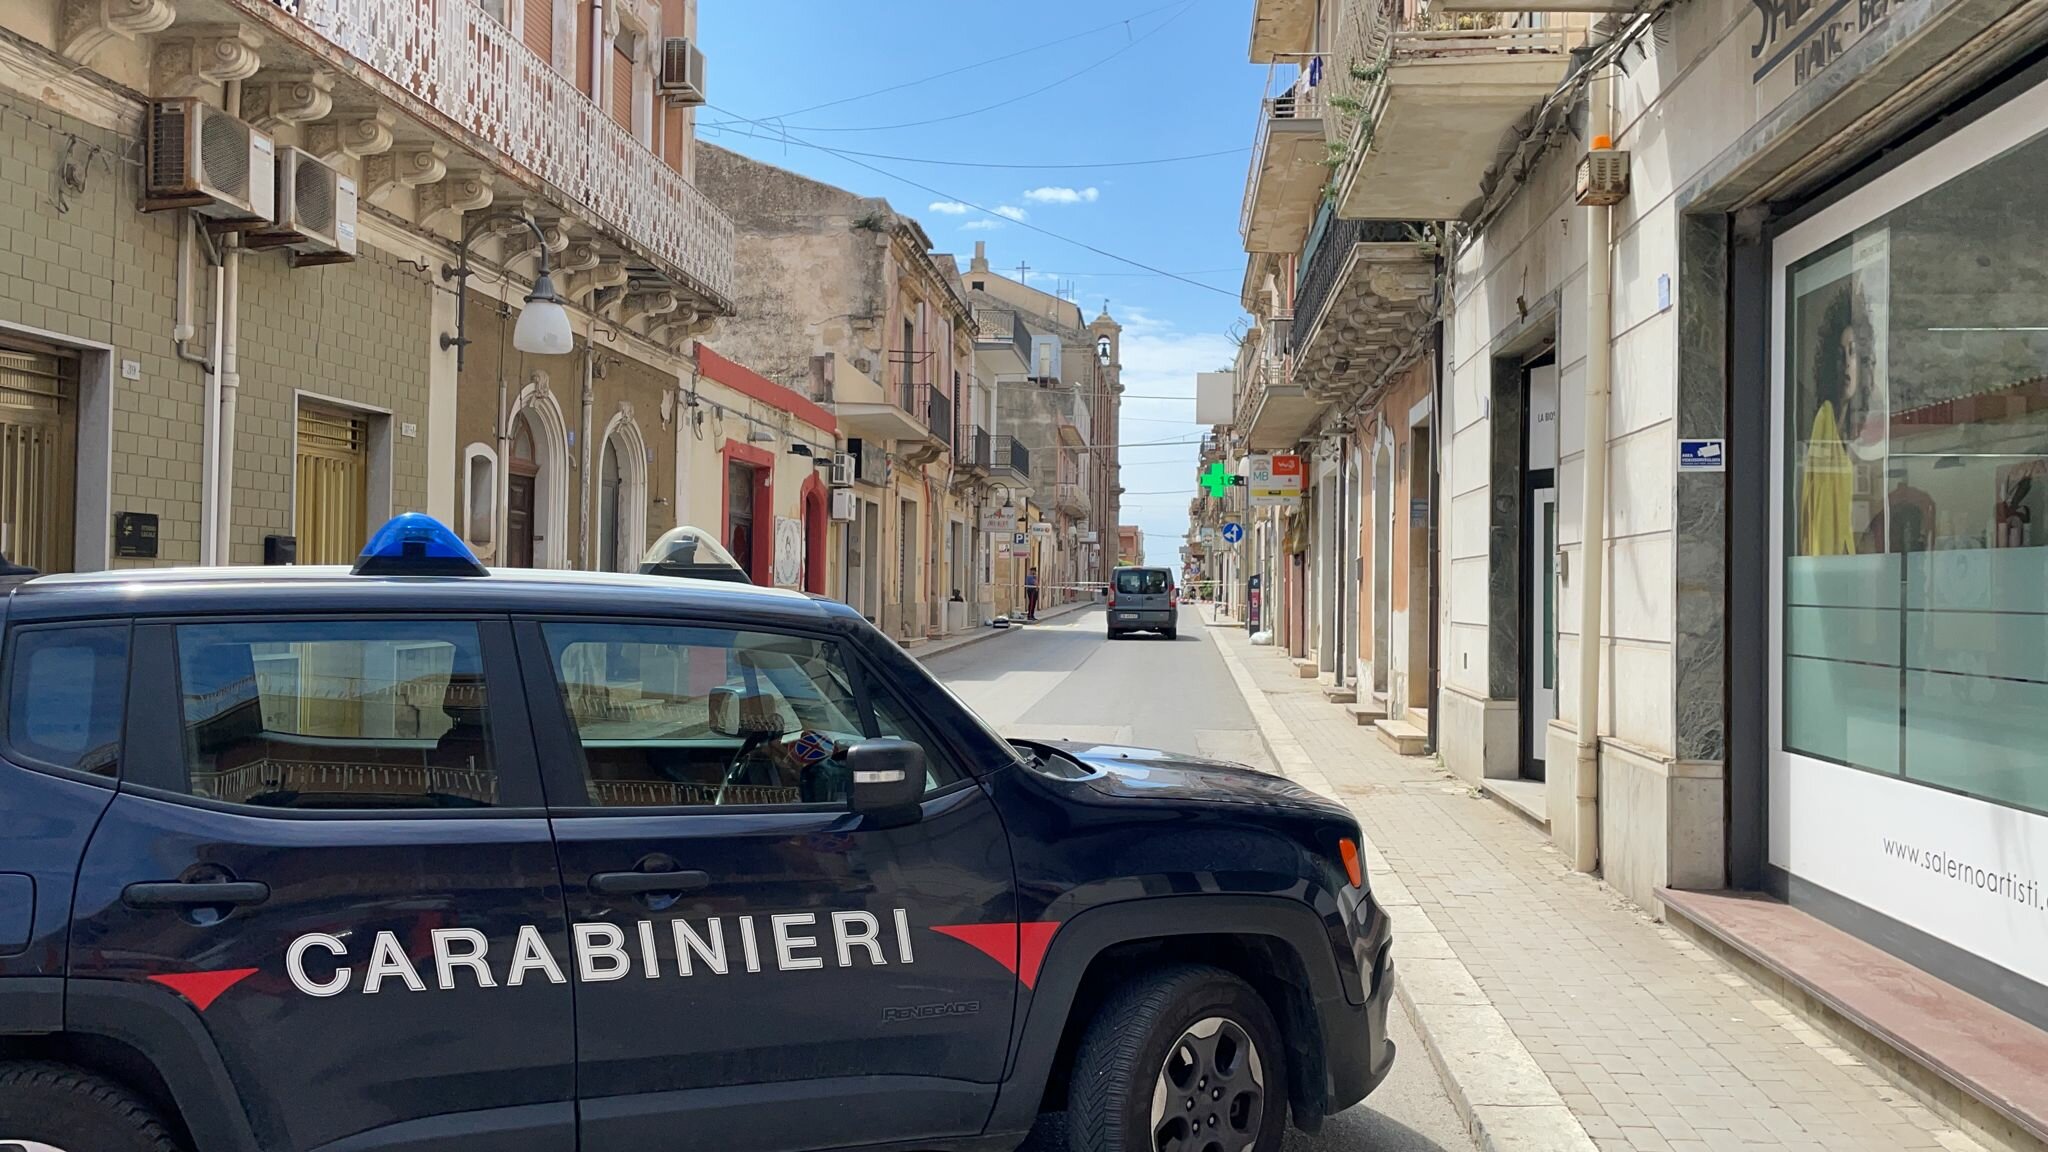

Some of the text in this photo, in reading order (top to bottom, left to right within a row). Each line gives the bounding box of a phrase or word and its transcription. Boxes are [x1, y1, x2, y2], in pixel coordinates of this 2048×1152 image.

[1016, 534, 1023, 543] P
[1253, 578, 1259, 586] P
[1883, 837, 2048, 912] www.salernoartisti.
[286, 908, 915, 999] CARABINIERI
[882, 1001, 980, 1023] RENEGADE
